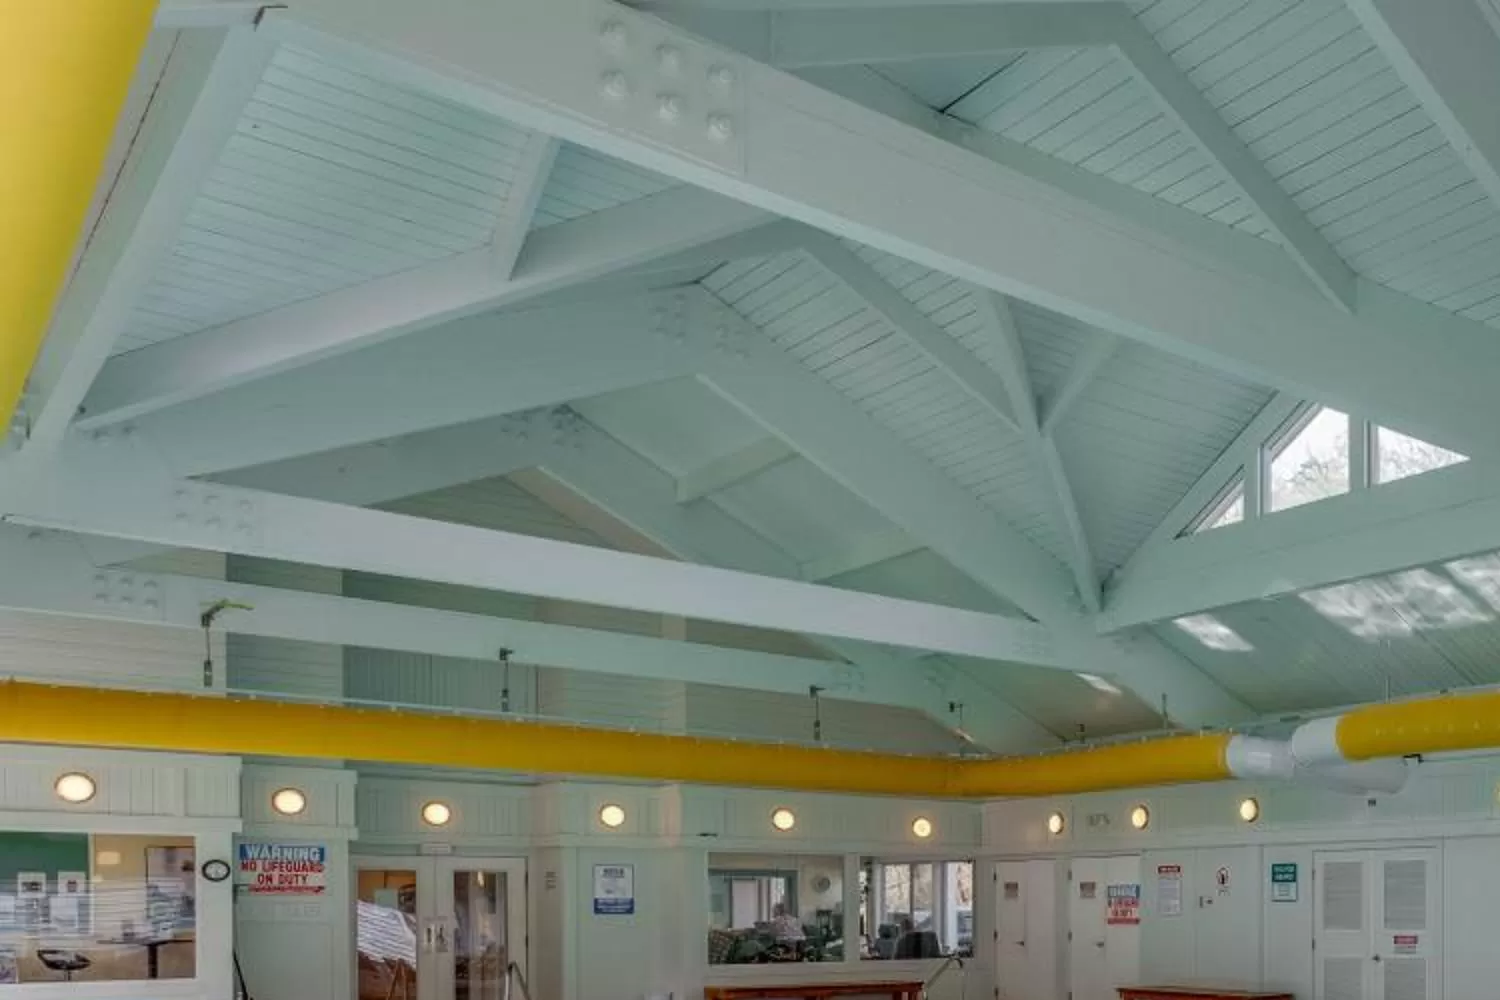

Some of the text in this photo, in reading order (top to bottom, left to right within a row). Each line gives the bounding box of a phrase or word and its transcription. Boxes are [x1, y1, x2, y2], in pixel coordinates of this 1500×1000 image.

[246, 845, 321, 860] WARNING
[241, 861, 324, 873] NO LIFEGUARD
[257, 874, 308, 885] ON DUTY
